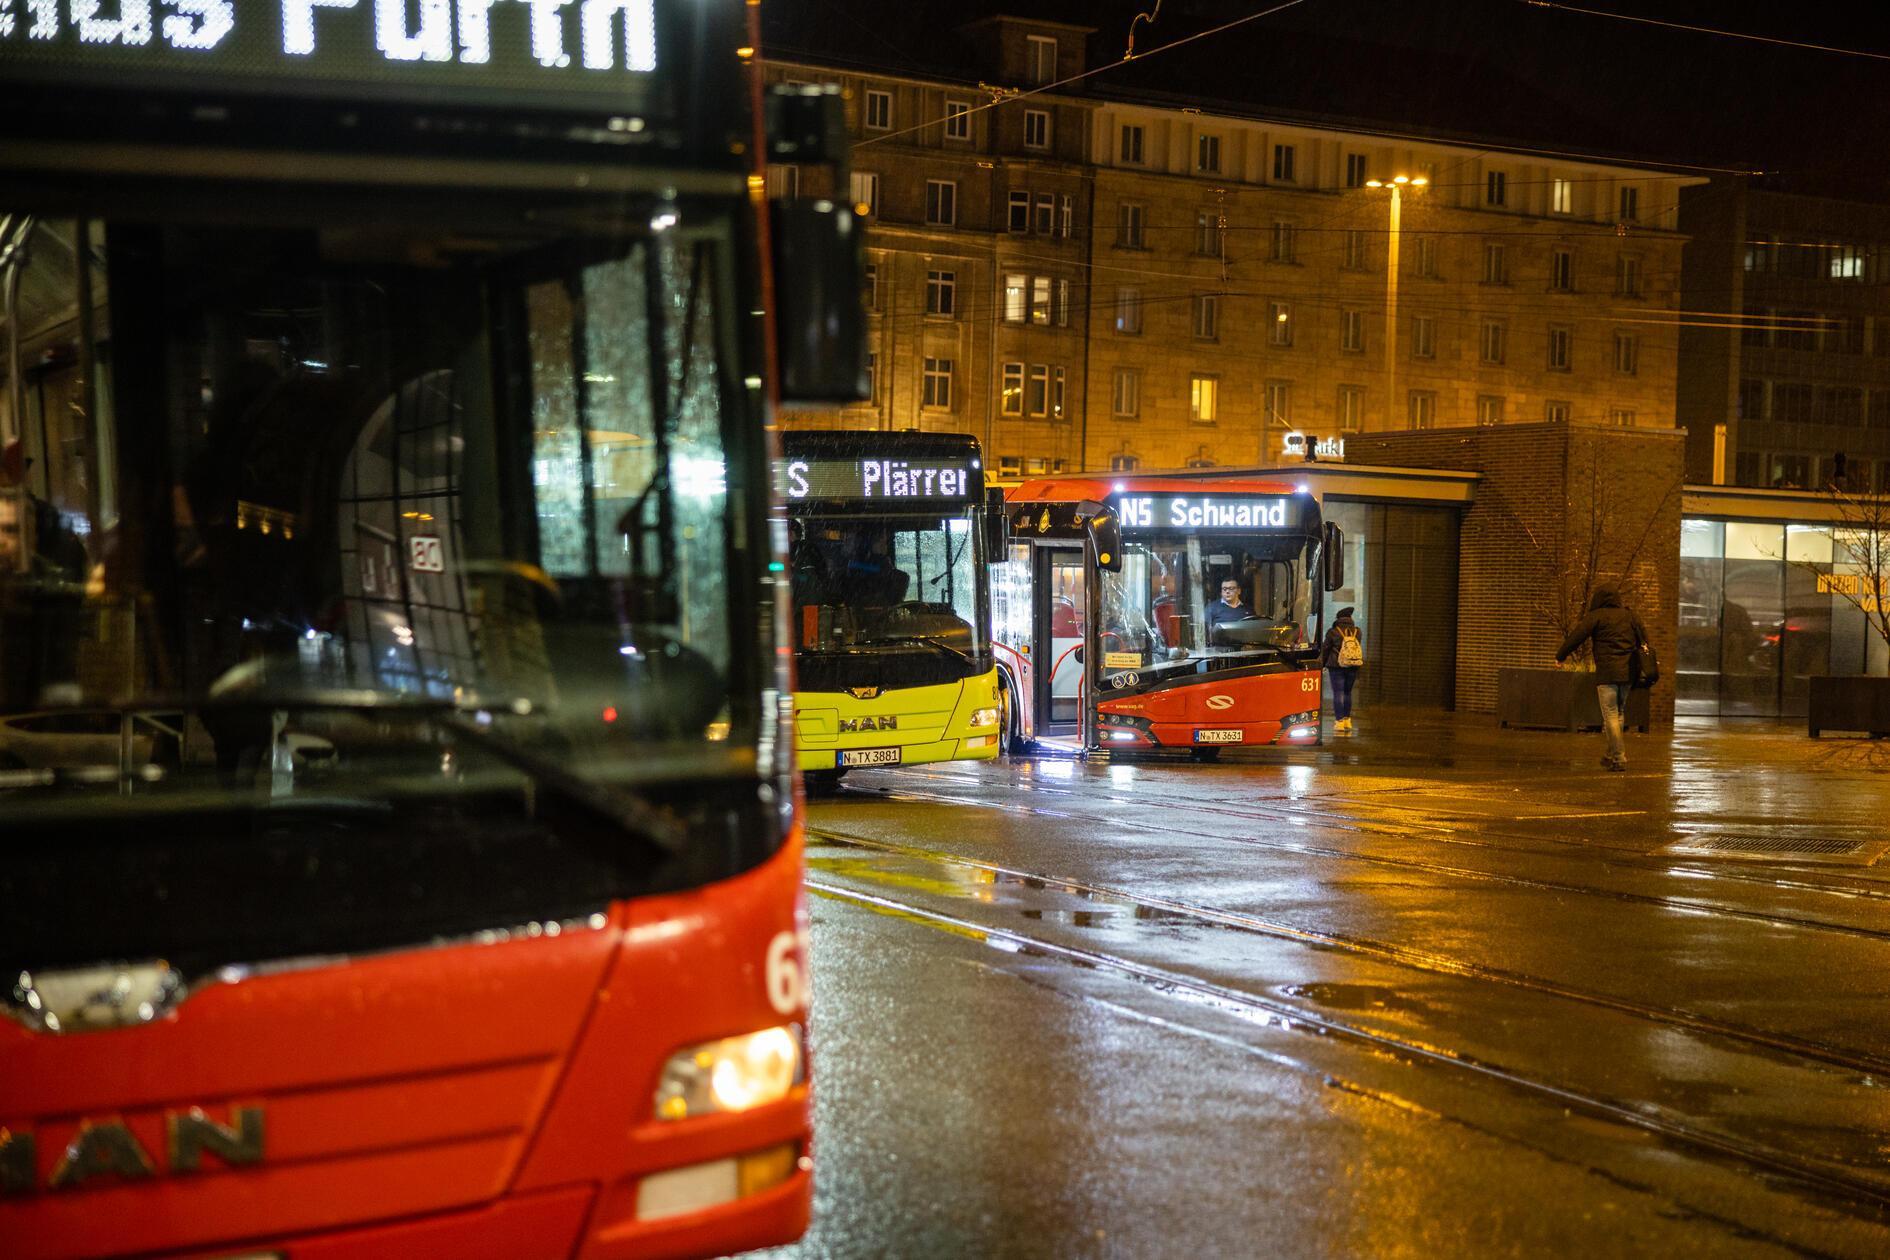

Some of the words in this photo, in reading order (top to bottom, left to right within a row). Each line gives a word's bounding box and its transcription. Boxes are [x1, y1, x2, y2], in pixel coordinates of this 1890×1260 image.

[863, 460, 967, 497] Plärrer
[1121, 498, 1152, 526] N5
[1171, 498, 1285, 526] Schwand
[1301, 677, 1319, 691] 631
[839, 715, 897, 732] MAN
[872, 750, 898, 762] 3881
